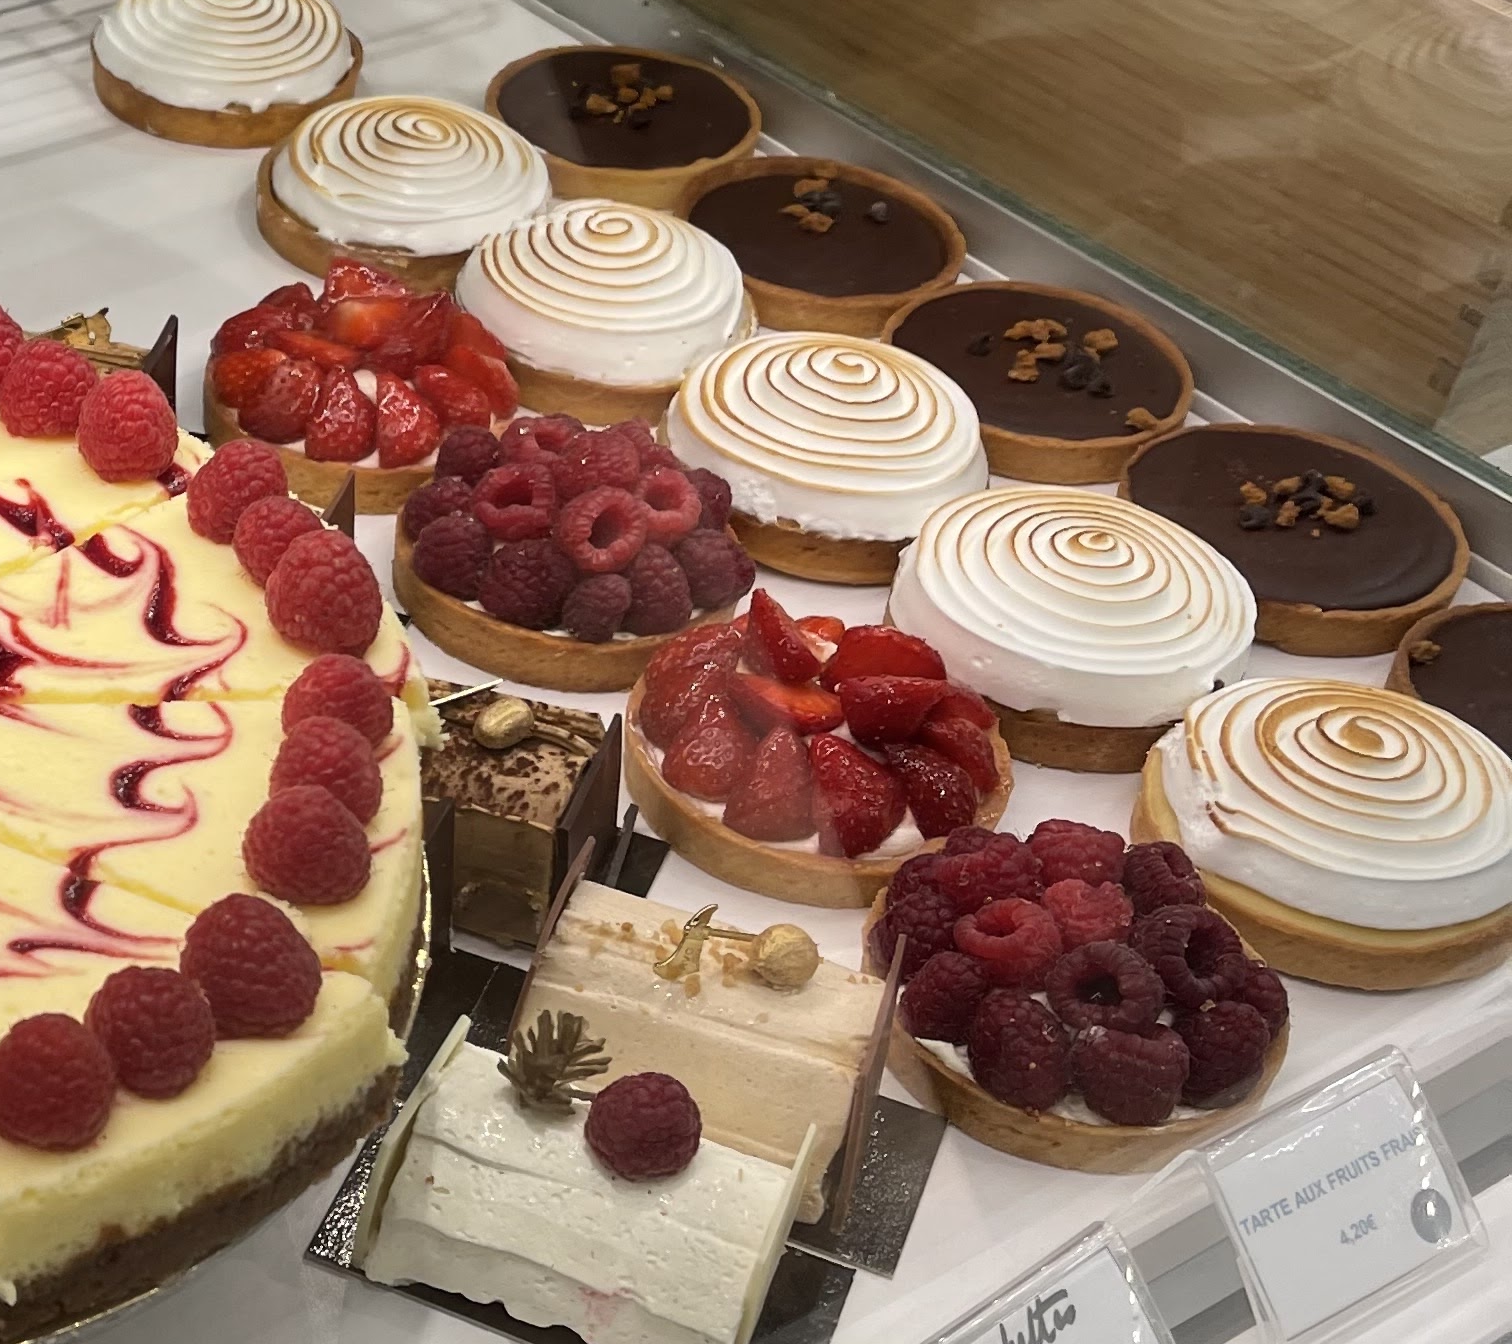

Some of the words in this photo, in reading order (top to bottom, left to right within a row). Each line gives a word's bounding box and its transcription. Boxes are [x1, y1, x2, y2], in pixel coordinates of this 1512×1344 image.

[1240, 1197, 1294, 1237] TARTE
[1295, 1178, 1328, 1210] AUX
[1326, 1149, 1381, 1191] FRUITS
[1340, 1213, 1379, 1246] 4,20€
